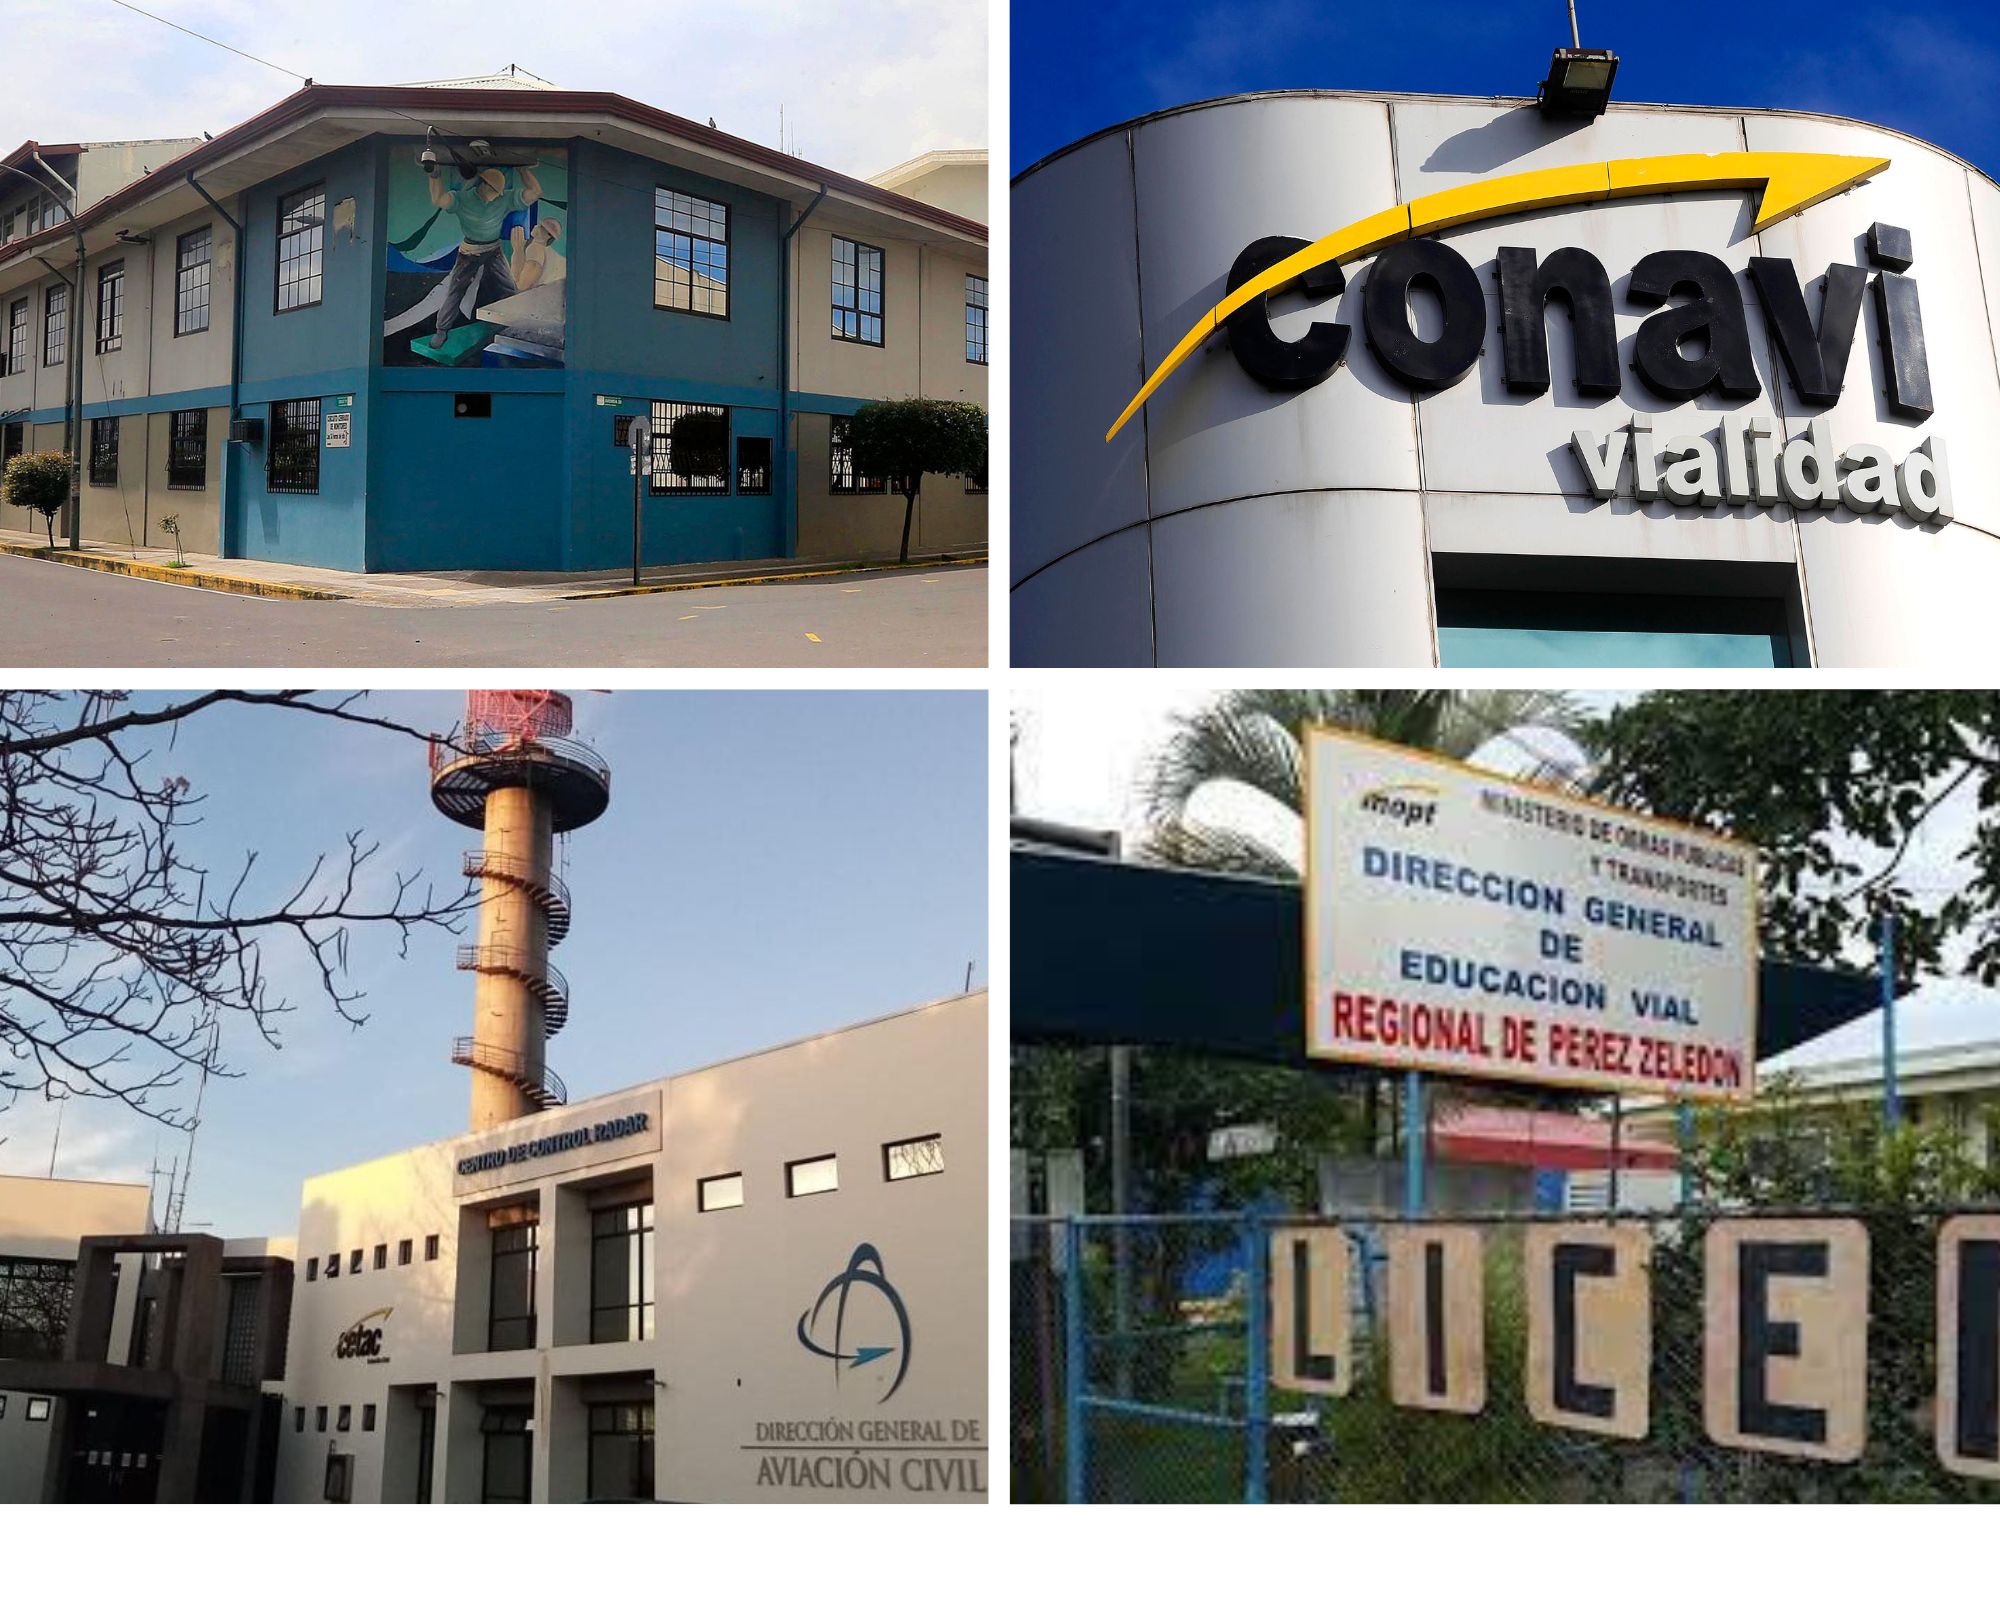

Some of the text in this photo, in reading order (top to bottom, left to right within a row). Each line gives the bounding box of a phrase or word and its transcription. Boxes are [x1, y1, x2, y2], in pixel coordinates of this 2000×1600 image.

[1225, 222, 1934, 421] conavi
[1571, 413, 1954, 528] vialidad
[1361, 792, 1437, 827] mopt
[1480, 789, 1584, 837] MINISTERIO
[1589, 818, 1612, 844] DE
[1363, 846, 1723, 948] DIRECCION GENERAL
[1540, 929, 1582, 963] DE
[1401, 949, 1698, 1026] EDUCACION VIAL
[1334, 991, 1741, 1088] REGIONAL DE PEREZ ZELEDON
[457, 1112, 650, 1175] CENTRO DE CONTROL RADAR
[337, 1323, 383, 1359] cetac
[756, 1416, 981, 1442] DIRECCIÓN GENERAL DE
[756, 1450, 989, 1494] AVIACIÓN CIVIL
